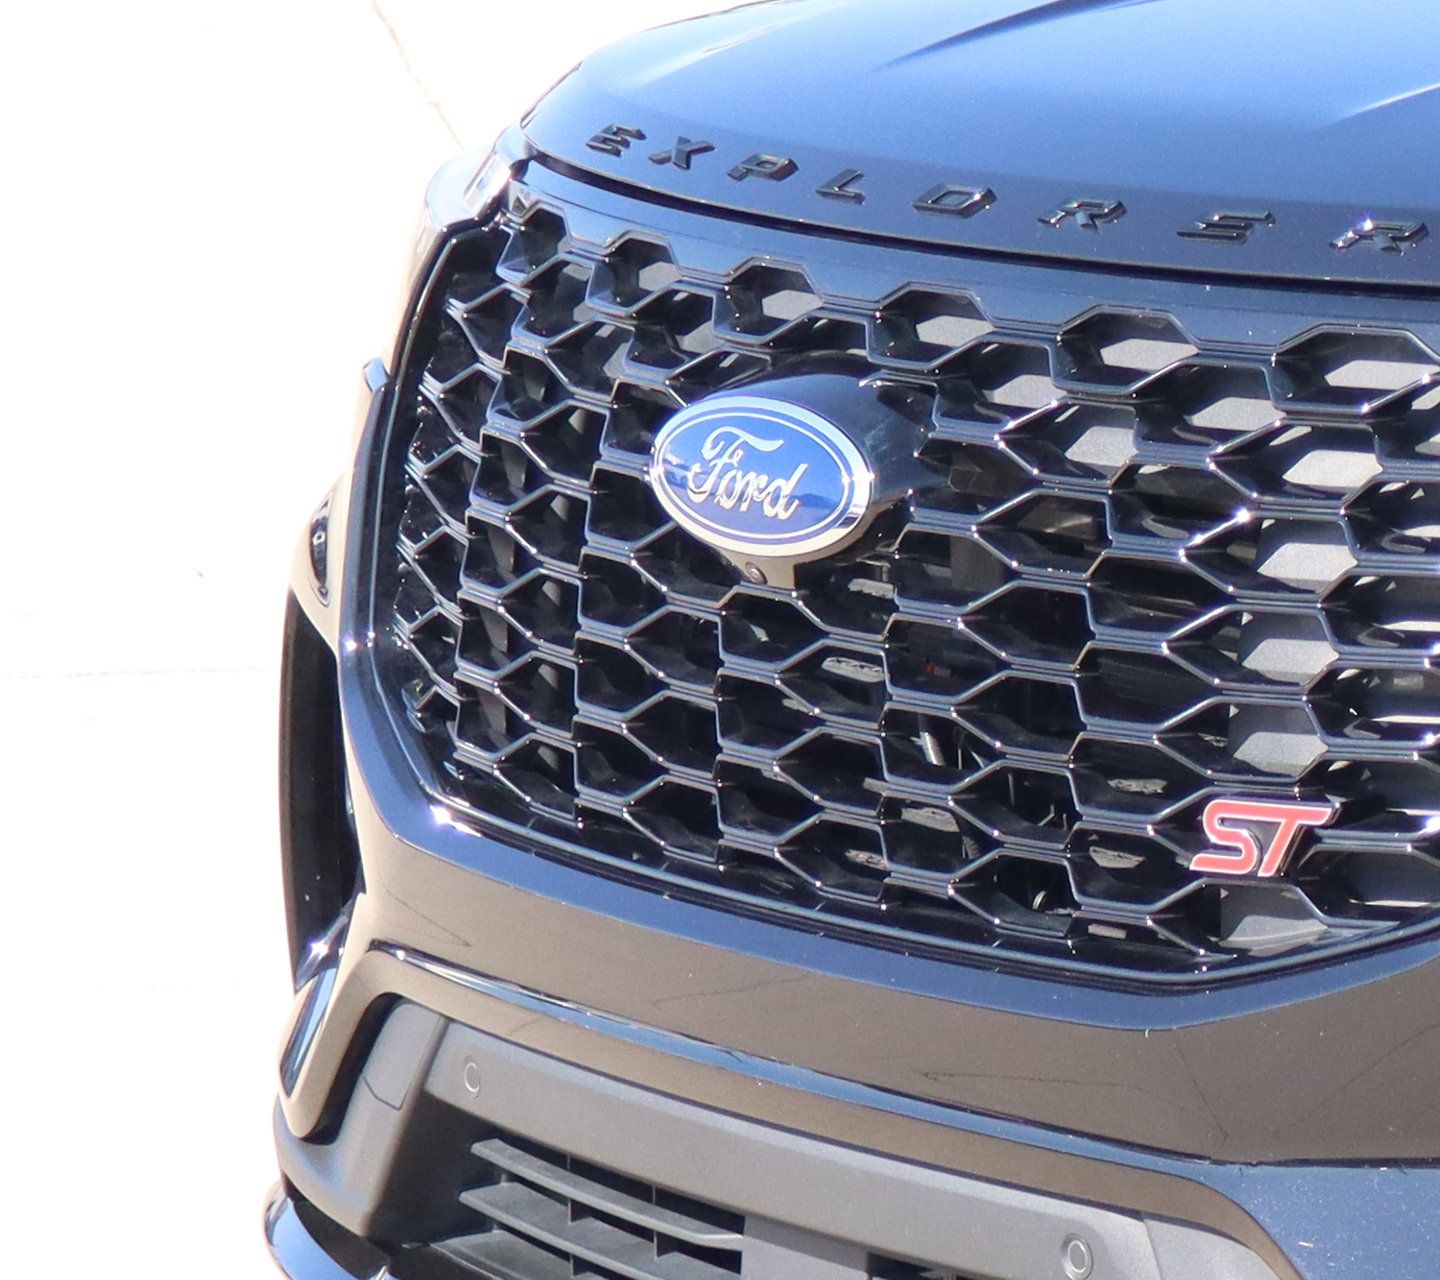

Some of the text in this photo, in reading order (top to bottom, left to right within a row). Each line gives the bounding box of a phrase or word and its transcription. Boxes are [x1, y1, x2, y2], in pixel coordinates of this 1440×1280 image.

[586, 123, 1428, 253] EXPLORER
[684, 424, 808, 522] Ford
[1190, 798, 1336, 876] ST
